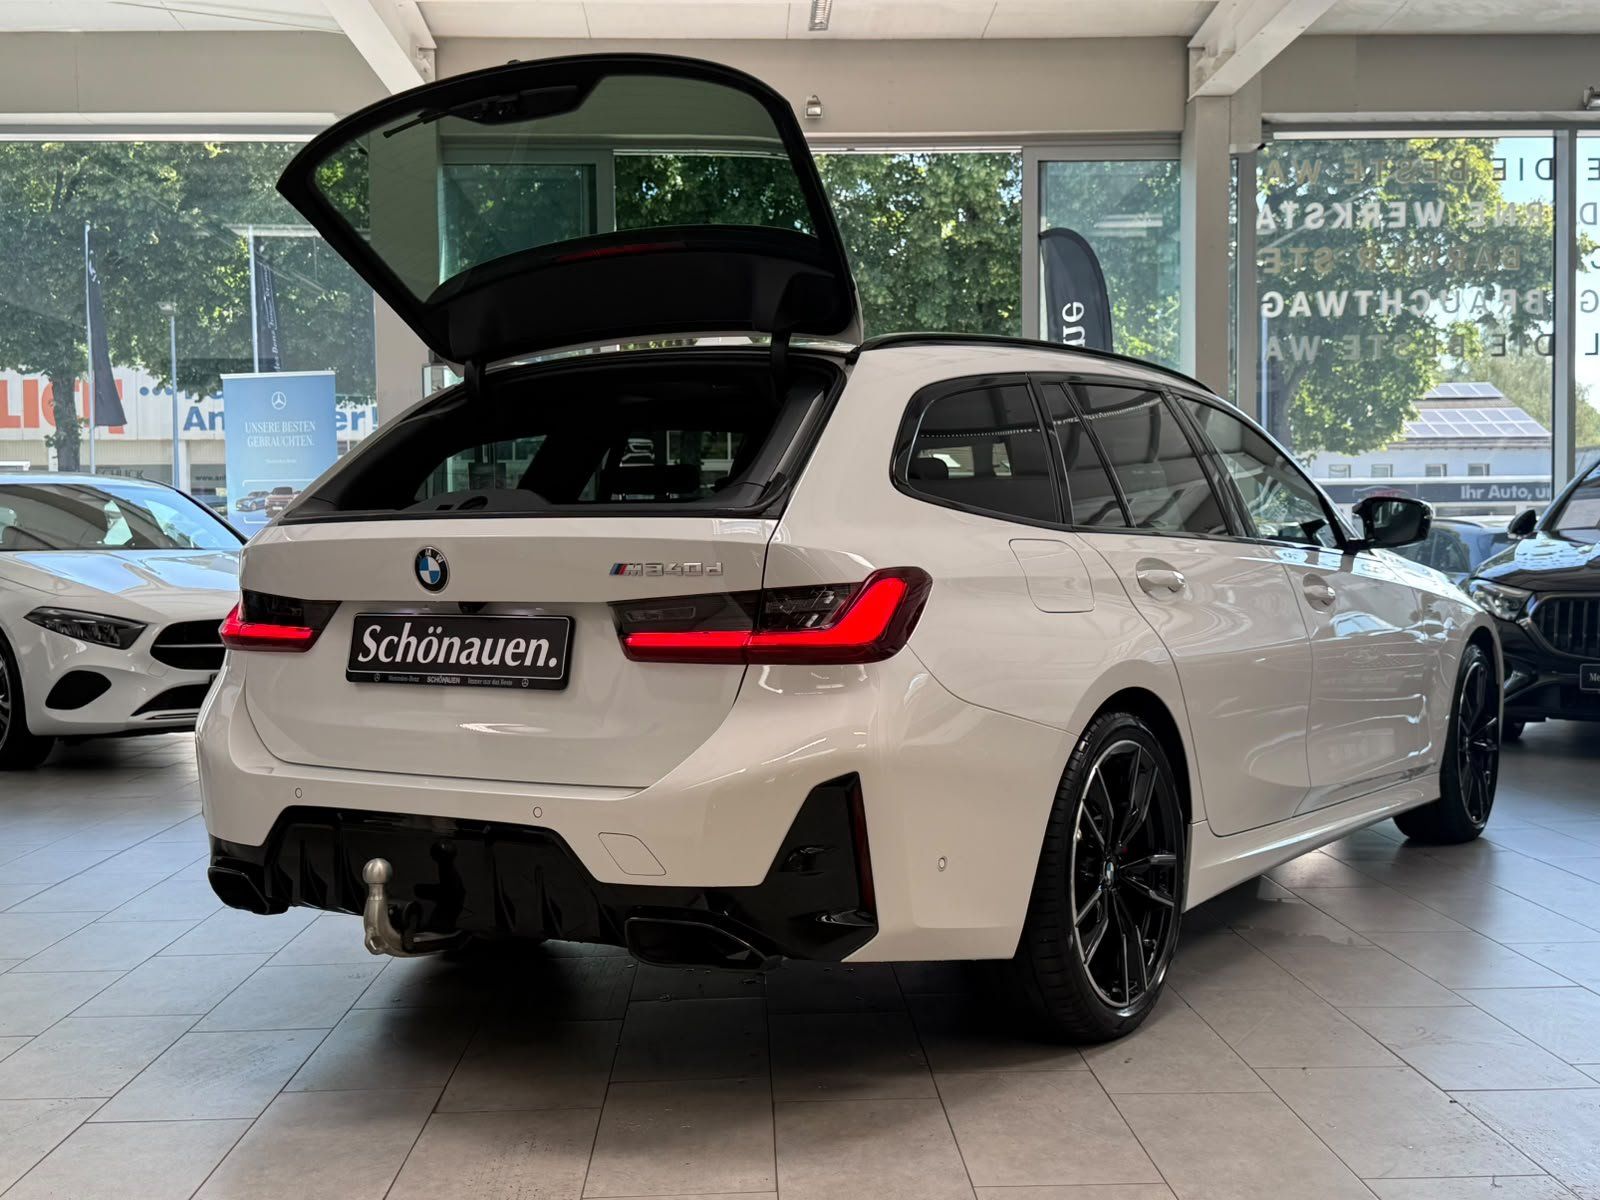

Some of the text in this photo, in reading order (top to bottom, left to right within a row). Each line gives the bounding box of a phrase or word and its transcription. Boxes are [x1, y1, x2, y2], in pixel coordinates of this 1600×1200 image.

[245, 420, 316, 433] UNSERE BESTEN
[247, 434, 315, 448] GEBRAUCHTEN.
[1460, 484, 1484, 499] Ihr
[1488, 484, 1532, 500] Auto,
[357, 622, 558, 668] Schönauen.
